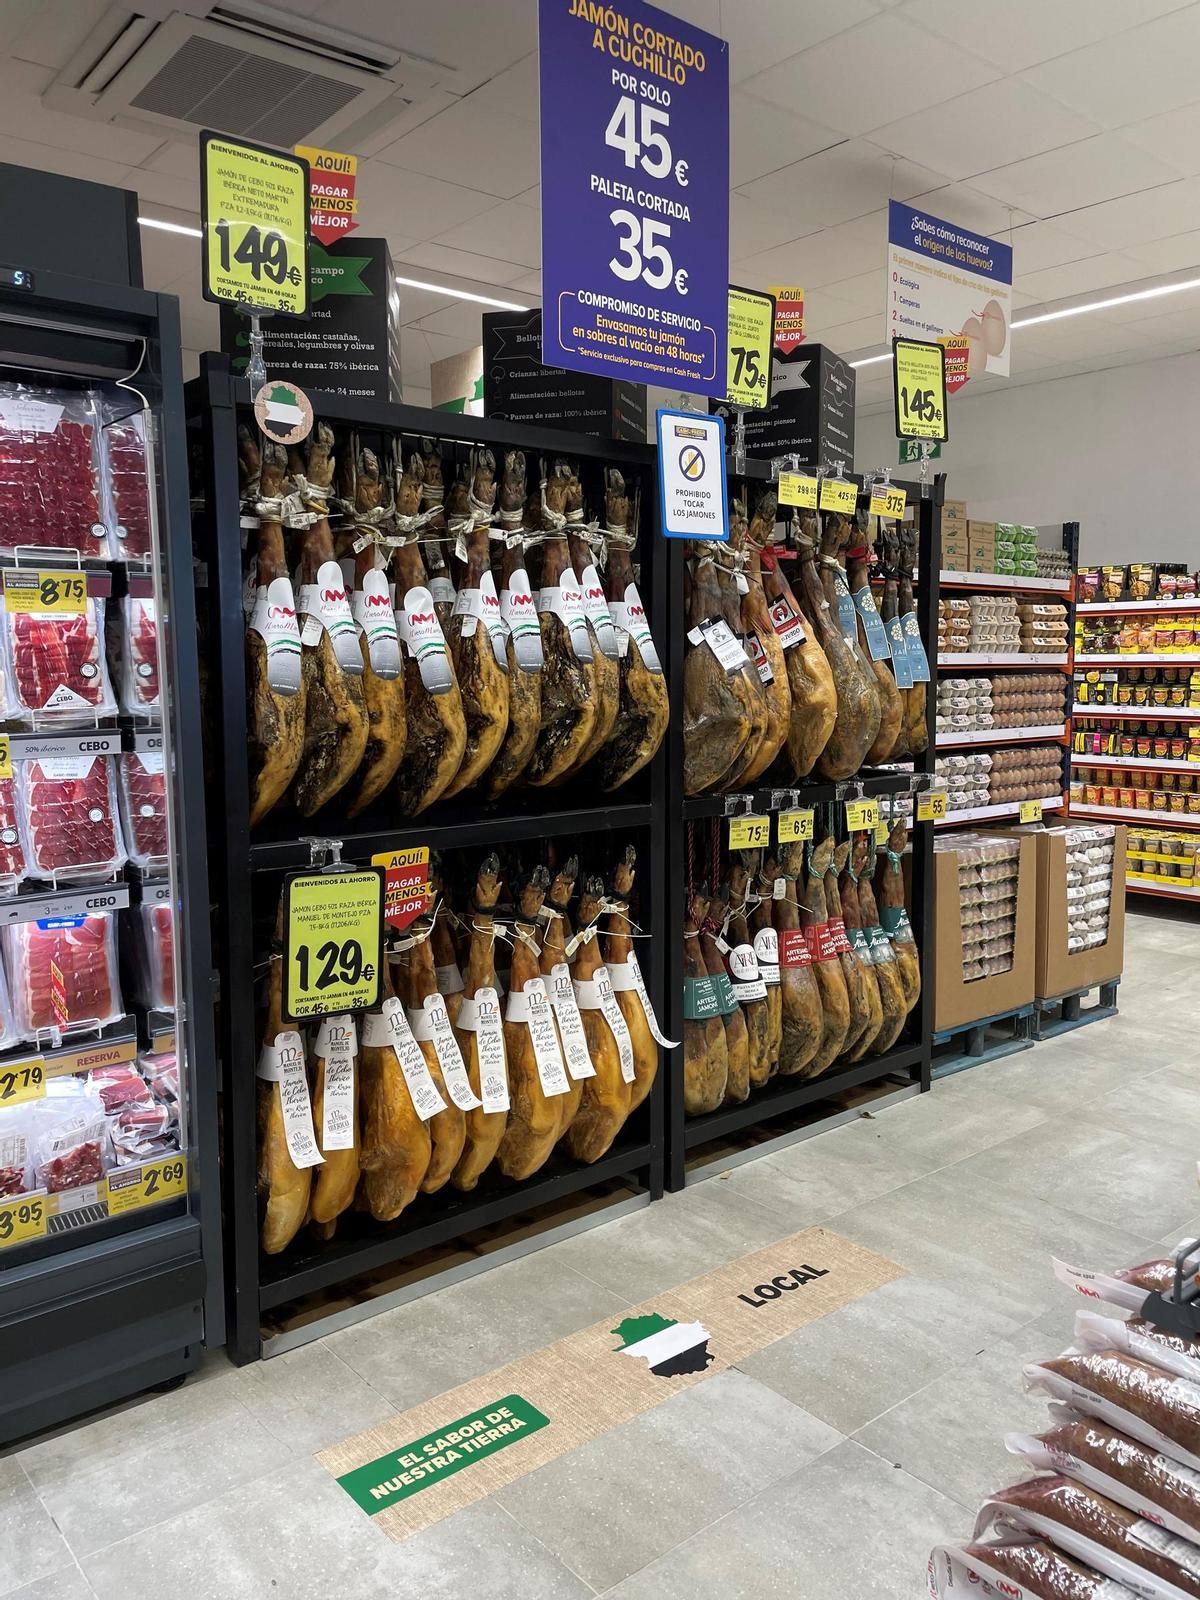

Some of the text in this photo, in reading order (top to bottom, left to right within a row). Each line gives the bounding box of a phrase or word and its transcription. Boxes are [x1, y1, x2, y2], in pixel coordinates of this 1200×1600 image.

[569, 0, 706, 72] JAMÓN CORTADO
[593, 29, 686, 86] A CUCHILLO
[612, 69, 671, 107] POR SOLO
[211, 144, 259, 162] BIENVENIDOS
[270, 161, 299, 174] AHORRO
[315, 155, 351, 173] AQUÍ!
[311, 184, 348, 198] PAGAR
[233, 194, 280, 212] EXTREMADURA
[310, 197, 353, 212] MENOS
[591, 175, 691, 222] PALETA CORTADA
[310, 214, 349, 228] MEJOR
[911, 216, 989, 255] ¿Sabes cómo reconocer
[915, 234, 993, 271] el origen de los huevos?
[217, 287, 232, 298] POR
[779, 289, 801, 301] AQUÍ!
[578, 290, 701, 332] COMPROMISO DE SERVICIO
[777, 312, 800, 320] PAGAR
[596, 314, 685, 346] Envasamos tu jamón
[776, 320, 803, 329] MENOS
[323, 333, 360, 342] castañas,
[573, 326, 678, 359] en sobres al vacío en 48
[775, 333, 801, 342] MEJOR
[298, 342, 341, 350] legumbres
[344, 343, 349, 351] y
[292, 361, 302, 369] de
[329, 362, 348, 370] 75%
[350, 361, 379, 371] ibérica
[604, 352, 701, 380] exclusivo para compras en Cash Fresh
[510, 369, 566, 378] Crianza: libertad
[337, 387, 347, 396] 24
[510, 389, 585, 400] Alimentación: bellotas
[510, 413, 534, 421] Pureza
[564, 410, 582, 418] 100%
[583, 409, 607, 418] ibérica
[676, 489, 711, 499] PROHIBIDO
[683, 500, 705, 508] TOCAR
[673, 509, 716, 520] LOS JAMONES
[25, 741, 110, 754] 50% ibérico CEBO
[390, 850, 423, 868] AQUÍ!
[295, 879, 339, 888] BIENVENIDOS
[387, 877, 422, 890] PAGAR
[385, 885, 426, 902] MENOS
[86, 896, 116, 908] CEBO
[385, 900, 422, 919] MEJOR
[297, 914, 321, 923] MANUEL
[332, 911, 357, 919] MONTEJO
[296, 1006, 310, 1015] POR
[77, 1050, 120, 1067] RESERVA
[737, 1264, 830, 1308] LOCAL
[398, 1406, 515, 1470] EL SABOR DE
[369, 1418, 528, 1500] NUESTRA TIERRA
